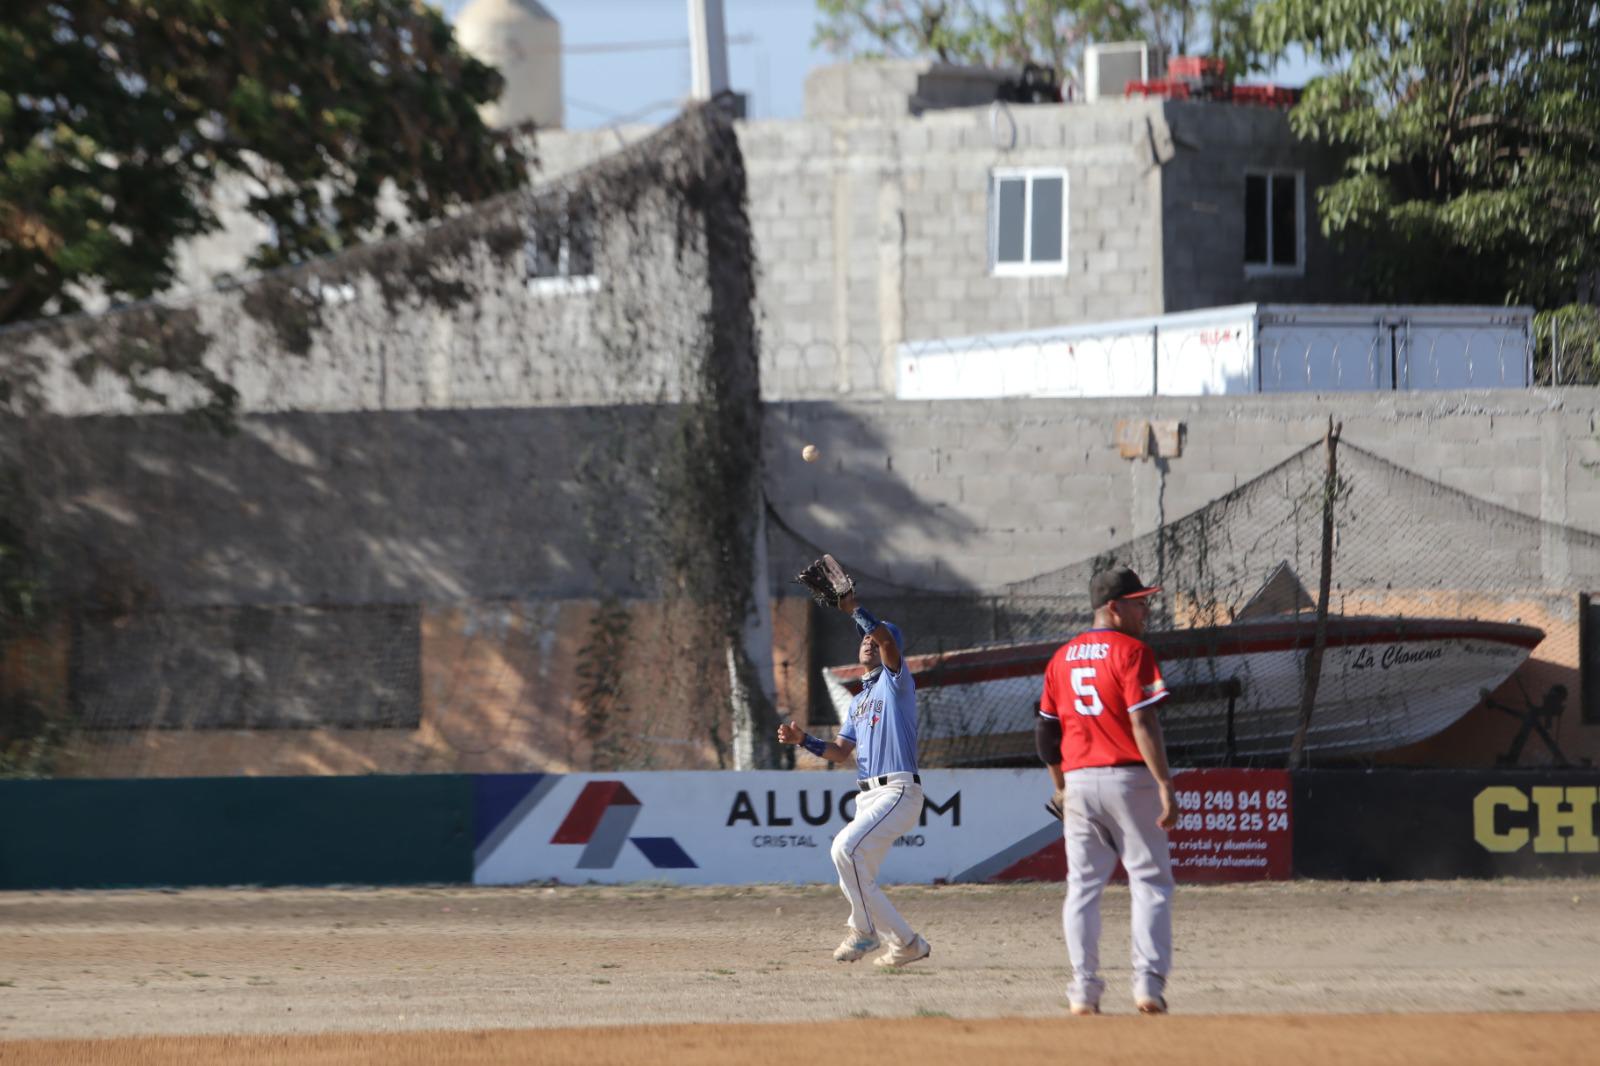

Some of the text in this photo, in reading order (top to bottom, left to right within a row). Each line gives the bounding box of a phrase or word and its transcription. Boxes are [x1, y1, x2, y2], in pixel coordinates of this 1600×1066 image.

[1070, 667, 1103, 716] 5
[726, 790, 961, 827] ALUCM
[1204, 790, 1234, 810] 249
[1238, 790, 1261, 810] 94
[1266, 789, 1287, 810] 62
[1205, 813, 1236, 832] 982
[1240, 813, 1263, 831] 25
[1268, 813, 1288, 832] 24
[1473, 786, 1600, 853] CH
[752, 834, 817, 848] CRISTAL
[1179, 838, 1212, 850] cristal
[1213, 841, 1222, 853] y
[1223, 838, 1267, 850] aluminio
